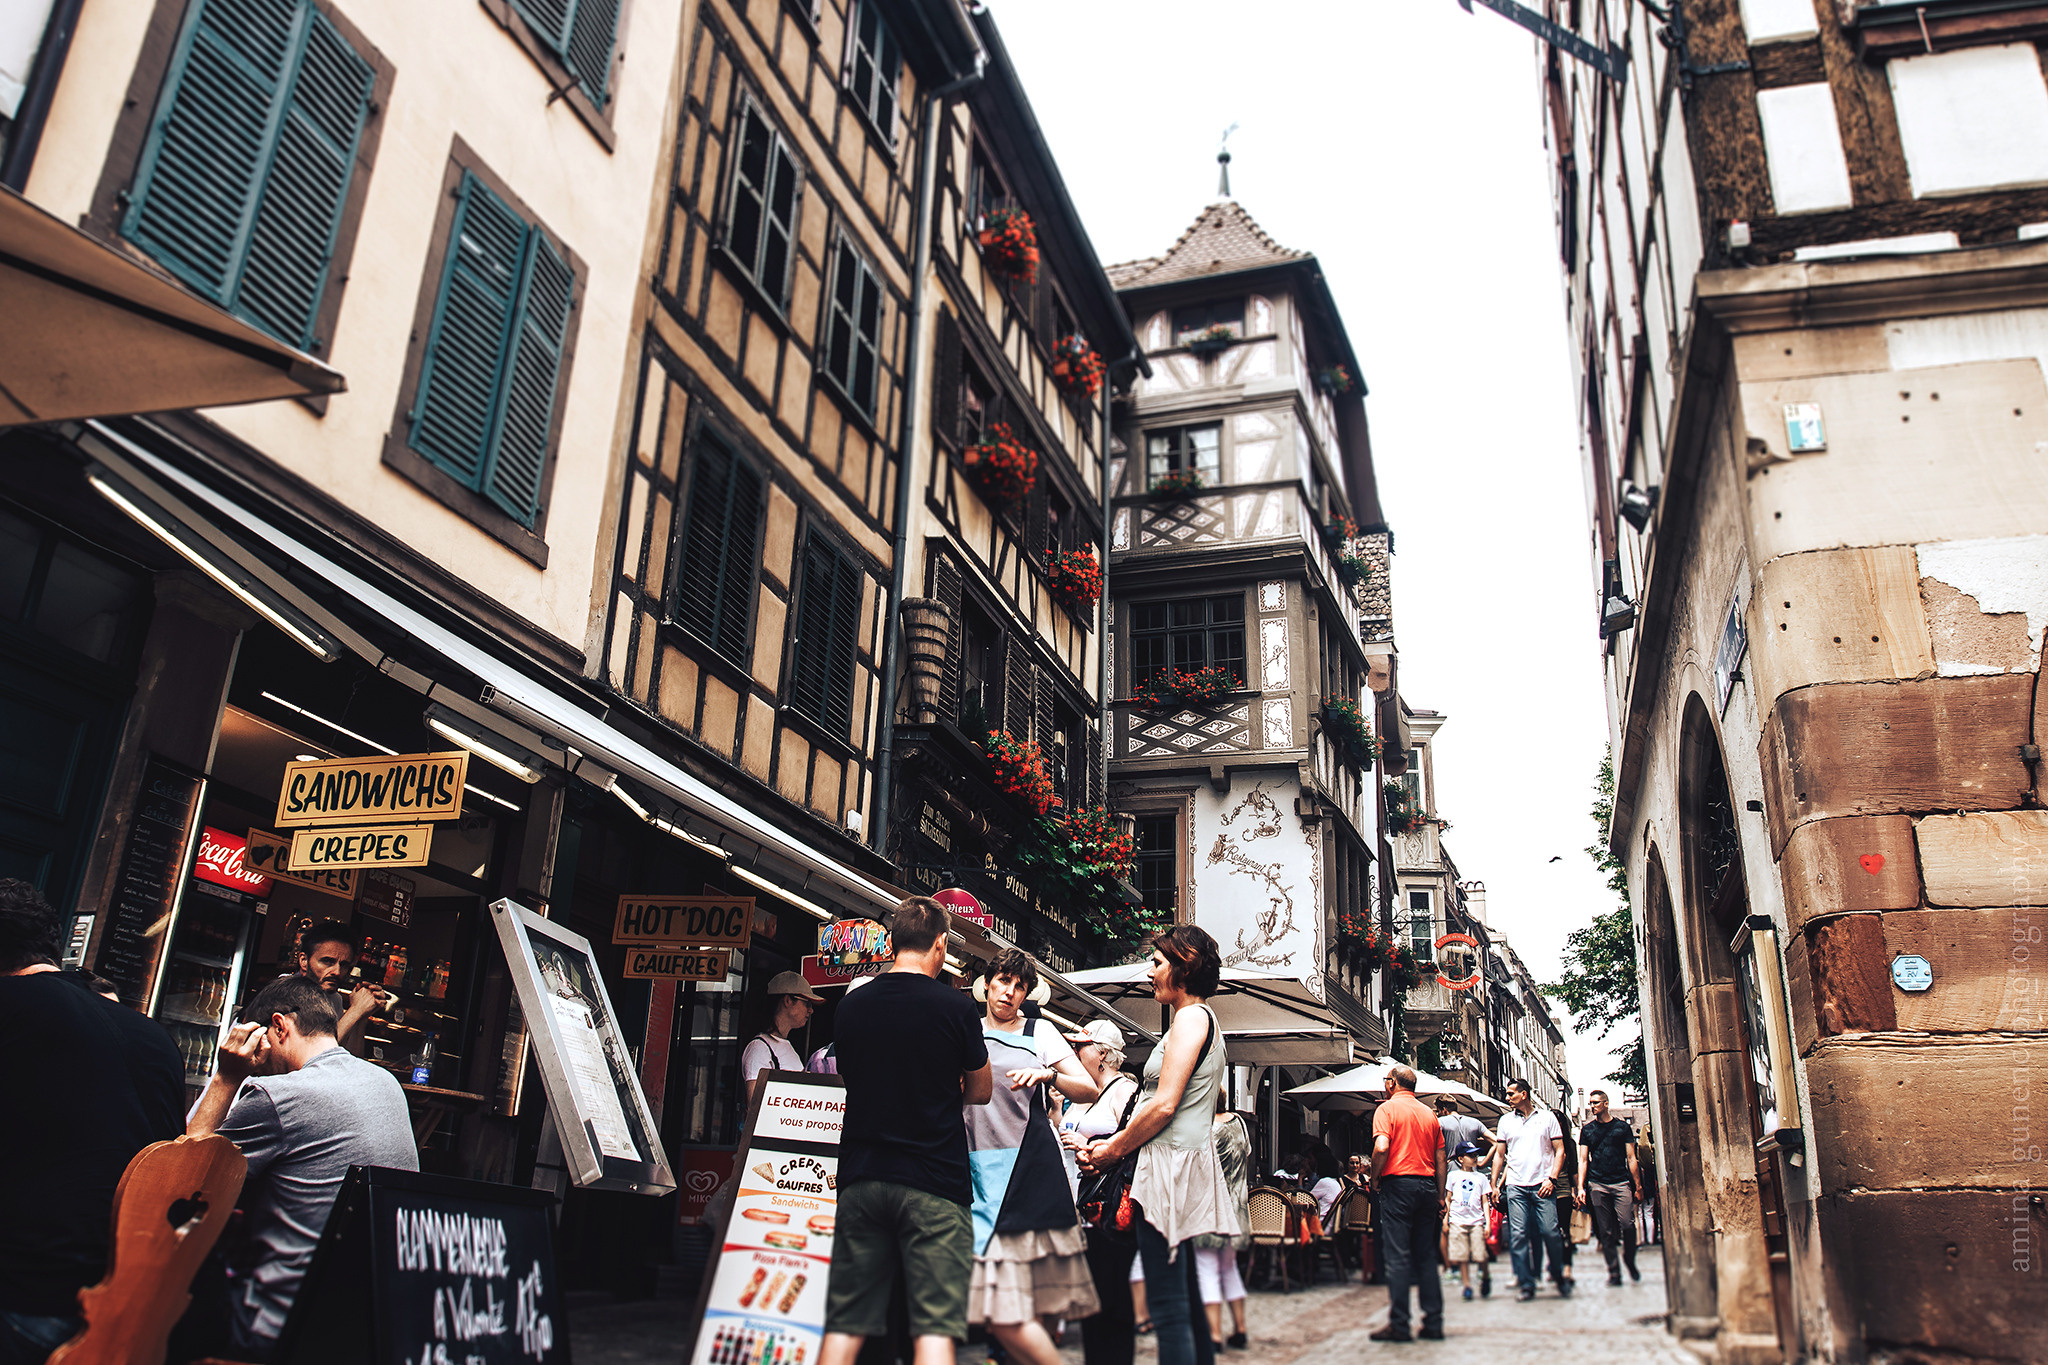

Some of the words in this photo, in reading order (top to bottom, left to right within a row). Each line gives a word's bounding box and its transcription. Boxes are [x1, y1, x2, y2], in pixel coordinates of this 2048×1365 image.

[286, 763, 455, 813] SANDWICHS
[309, 833, 408, 864] CREPES
[1225, 844, 1267, 872] Restaurant
[946, 903, 975, 914] Vieux
[622, 903, 744, 938] HOT'DOG
[632, 953, 719, 976] GAUFRES
[1445, 981, 1473, 989] WINSTUB
[767, 1096, 782, 1107] LE
[783, 1097, 823, 1111] CREAM
[780, 1117, 803, 1127] vous
[779, 1157, 827, 1180] CREPES
[776, 1179, 823, 1194] GAUFRES
[688, 1194, 712, 1203] MIKO
[771, 1195, 820, 1210] Sandwichs
